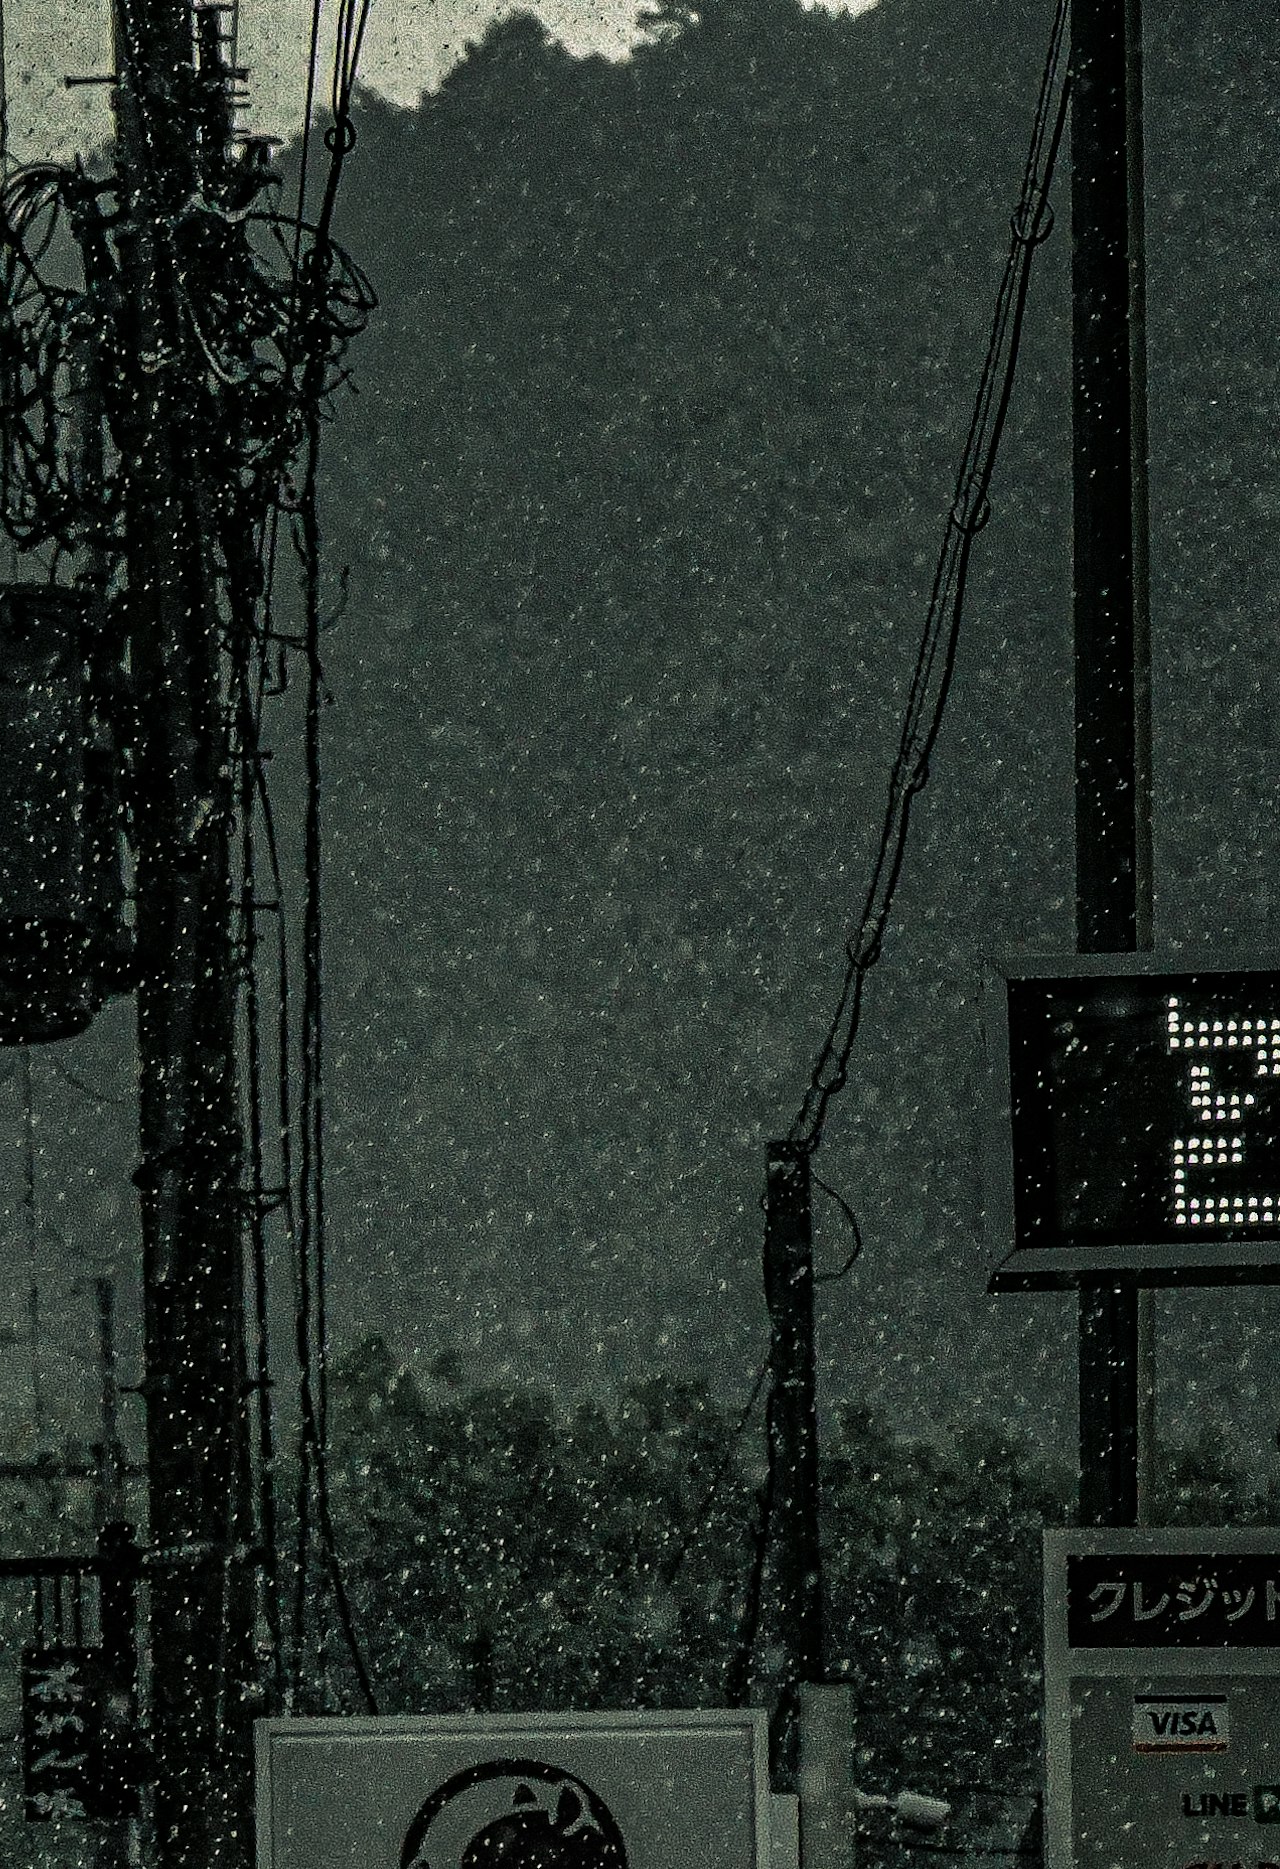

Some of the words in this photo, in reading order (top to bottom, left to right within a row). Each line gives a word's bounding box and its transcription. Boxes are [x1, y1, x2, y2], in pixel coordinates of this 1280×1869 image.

[1088, 1577, 1280, 1623] クレジット
[1147, 1711, 1217, 1735] VISA
[1182, 1794, 1247, 1817] LINE
